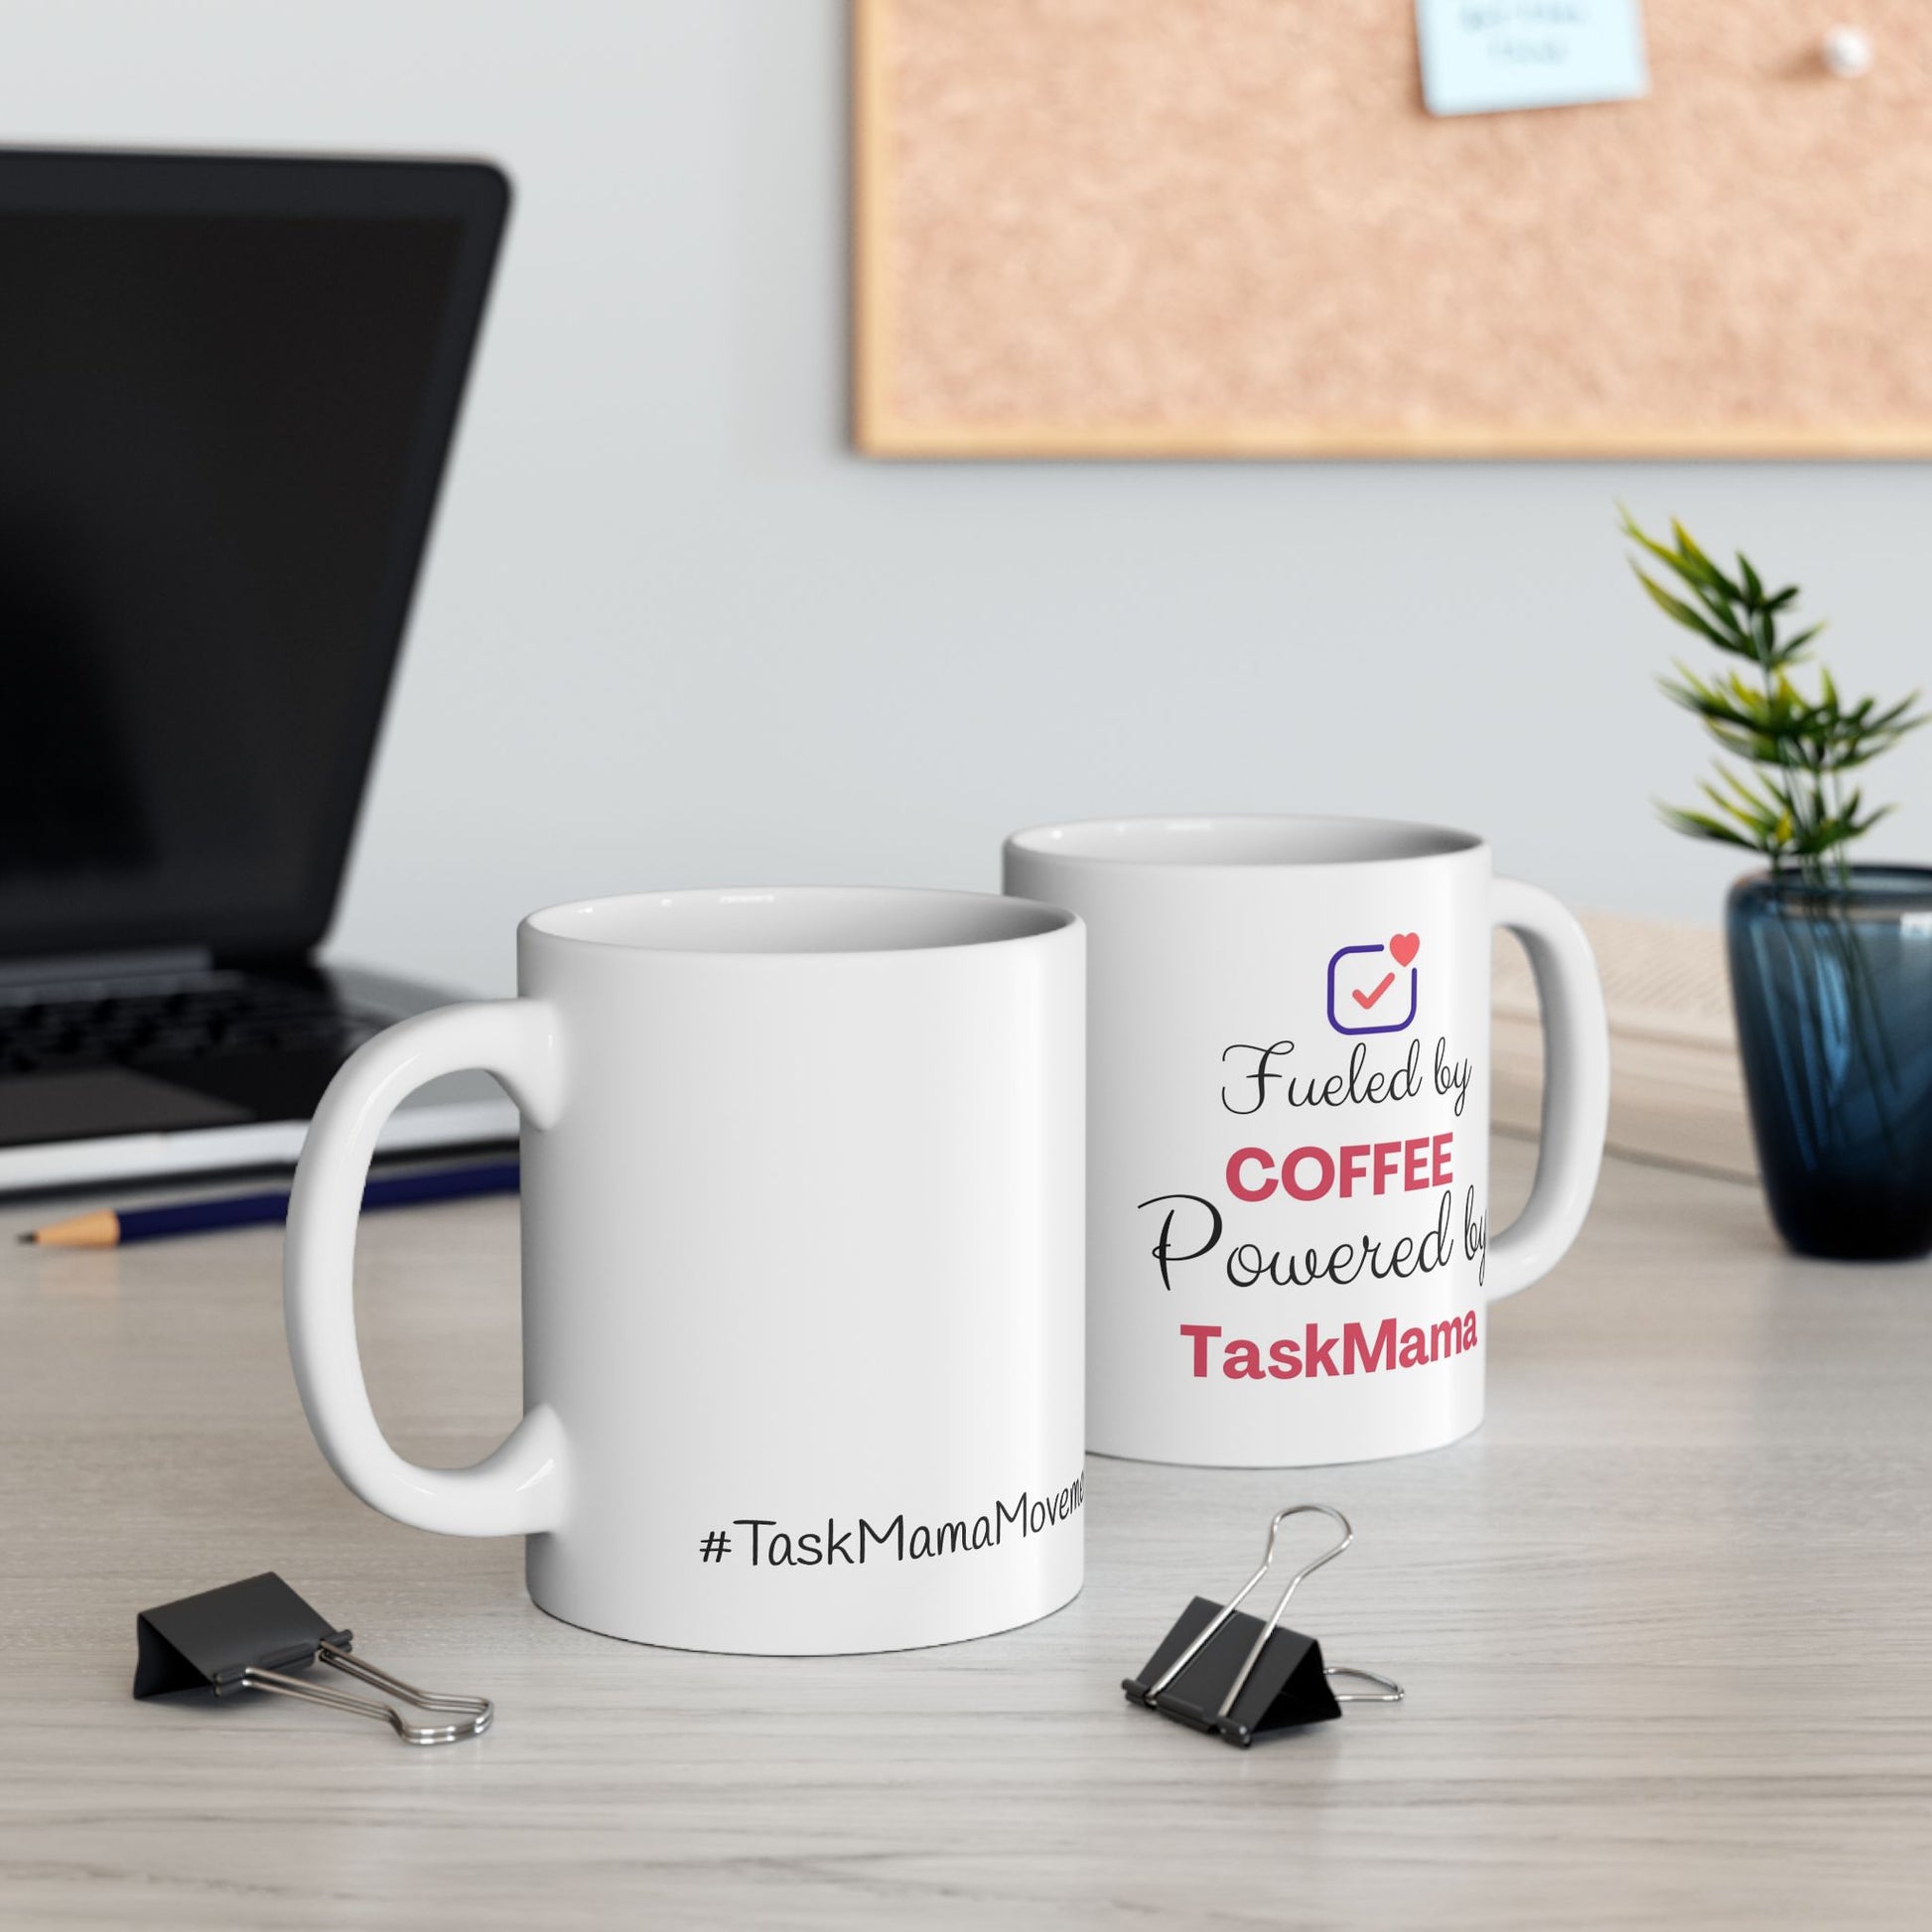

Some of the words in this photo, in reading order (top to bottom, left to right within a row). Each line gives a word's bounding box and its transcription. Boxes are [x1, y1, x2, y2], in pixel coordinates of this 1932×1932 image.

[1221, 1038, 1423, 1115] Fueled
[1434, 1036, 1473, 1117] by
[1225, 1132, 1453, 1202] COFFEE
[1137, 1189, 1454, 1292] Powered
[1463, 1183, 1487, 1288] by
[1179, 1310, 1478, 1380] TaskMama
